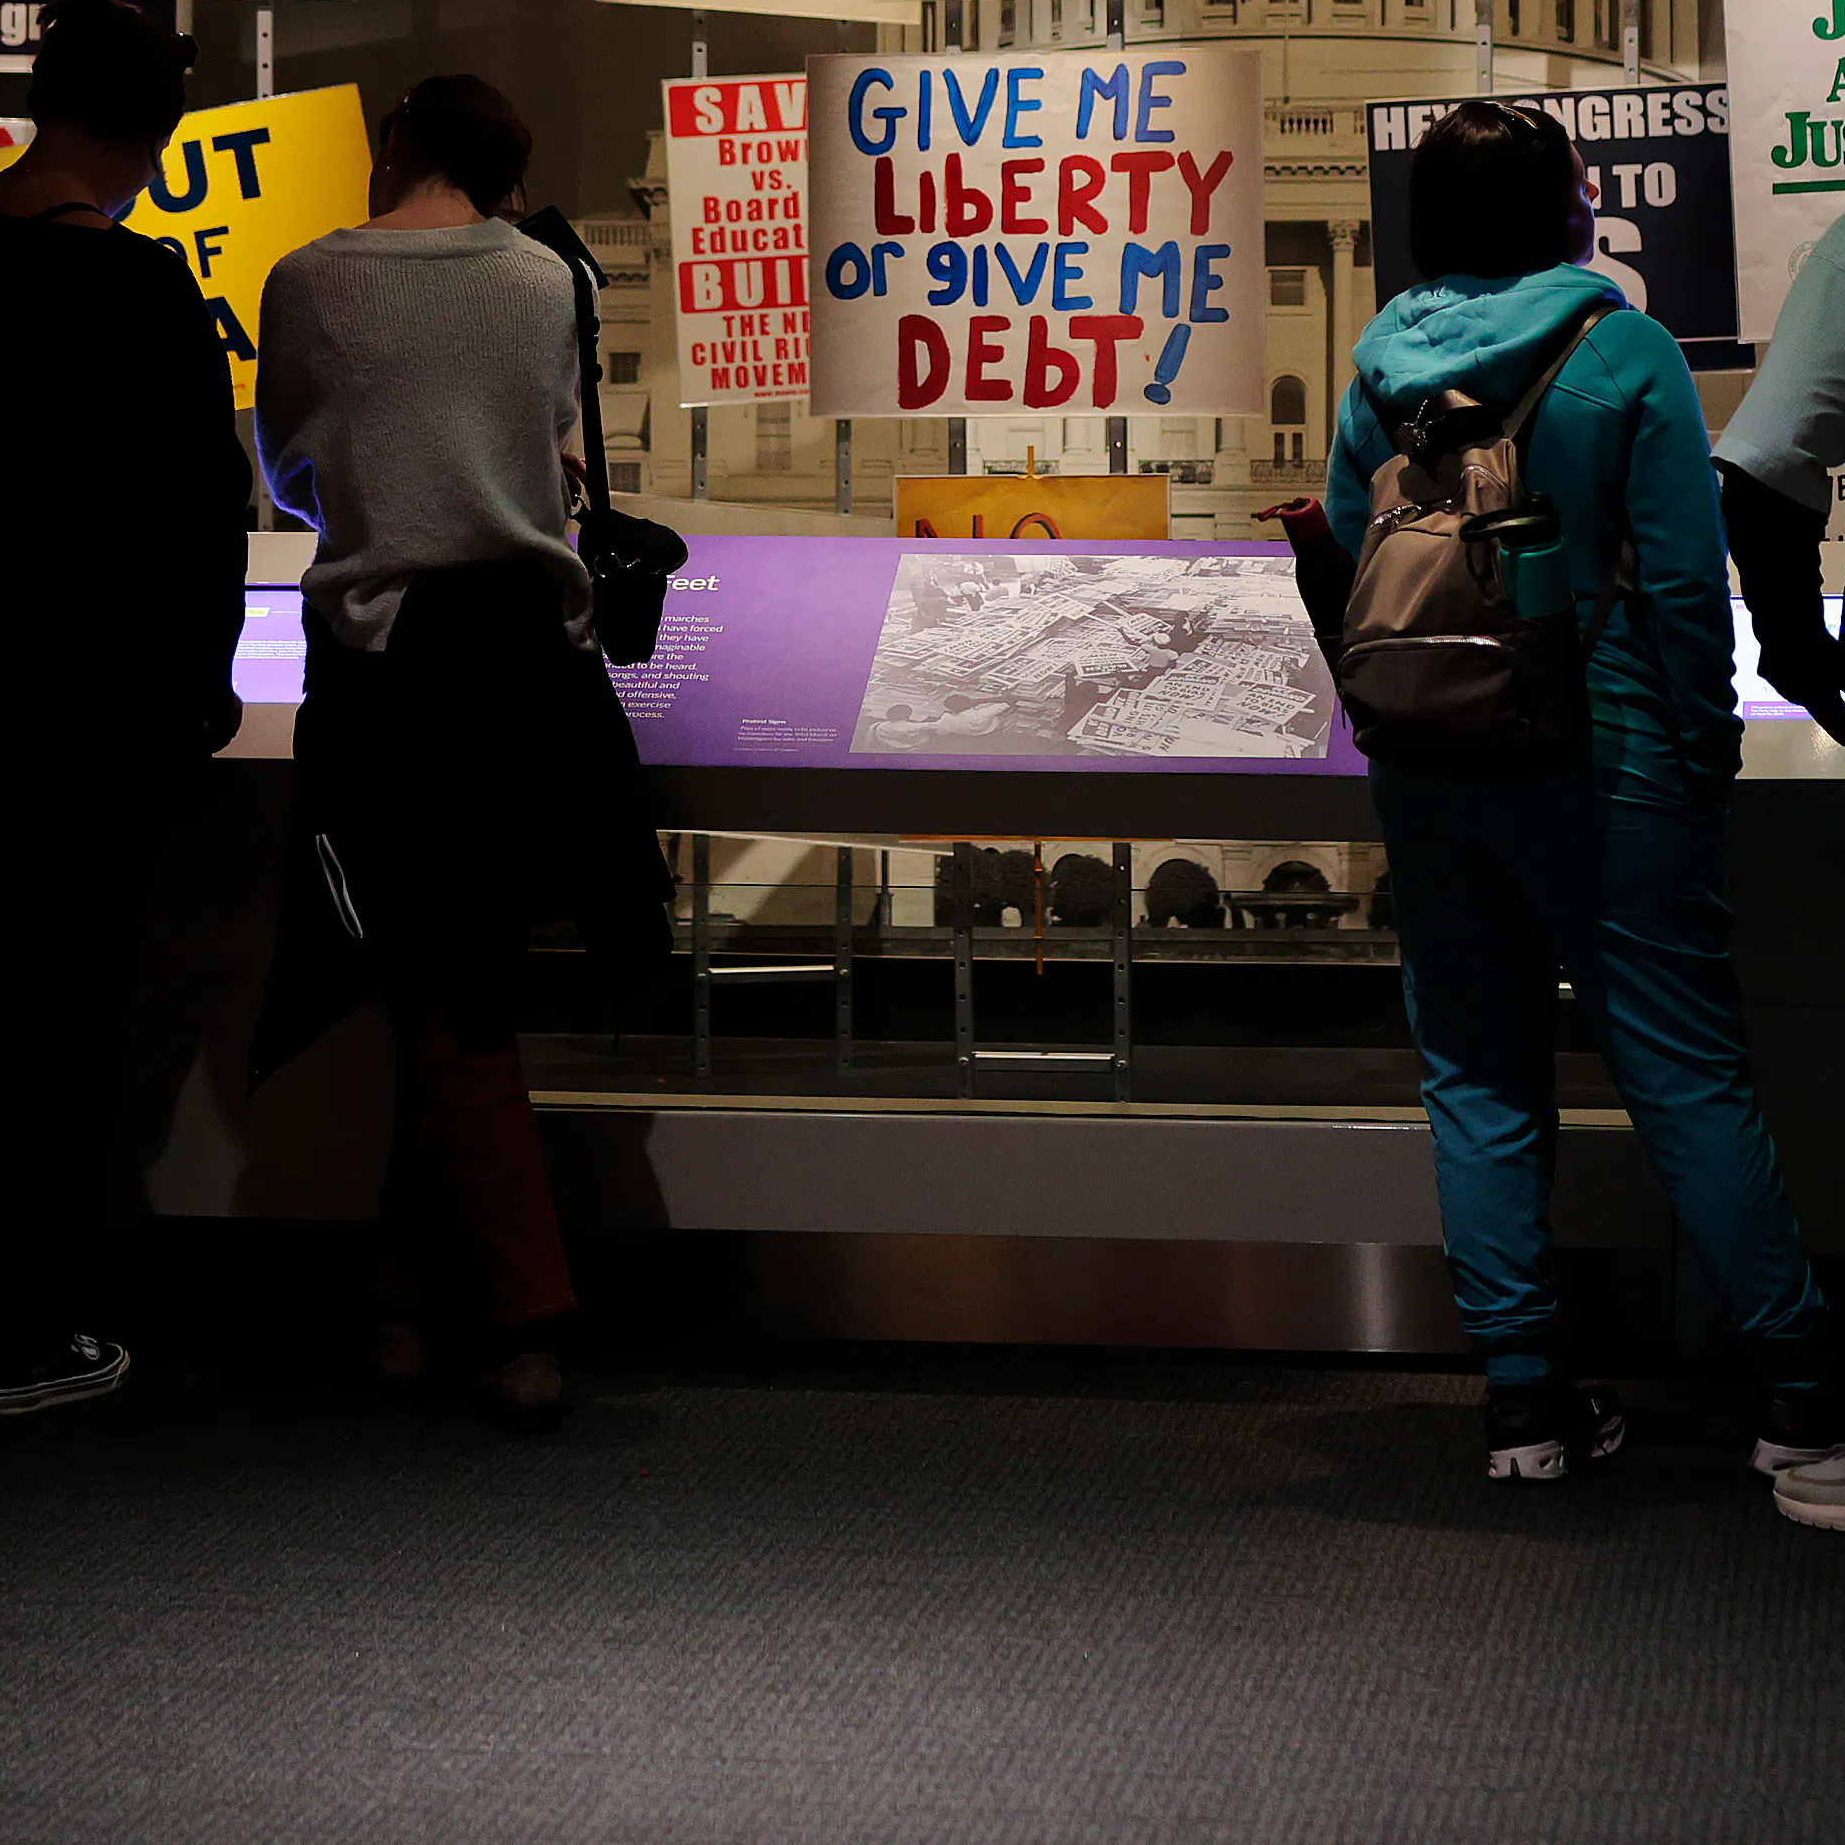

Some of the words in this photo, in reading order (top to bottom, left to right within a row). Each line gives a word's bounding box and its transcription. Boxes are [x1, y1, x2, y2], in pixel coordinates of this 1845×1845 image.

[693, 82, 806, 134] SAV
[849, 67, 1044, 155] GIVE
[1076, 63, 1187, 143] ME
[718, 139, 809, 166] Brow
[751, 169, 792, 192] vs.
[1612, 161, 1677, 210] TO
[703, 191, 799, 224] Board
[826, 241, 904, 300] or
[1120, 240, 1232, 323] ME
[723, 314, 770, 339] THE
[692, 340, 763, 366] CIVIL
[711, 362, 806, 390] MOVEM
[664, 615, 710, 623] marches
[689, 625, 724, 633] forced
[659, 634, 683, 643] they
[684, 634, 709, 642] have
[637, 662, 648, 670] to
[649, 662, 663, 670] be
[665, 662, 698, 670] heard.
[641, 672, 662, 680] and
[663, 672, 710, 682] shouting
[626, 691, 677, 700] offensive,
[659, 681, 681, 690] and
